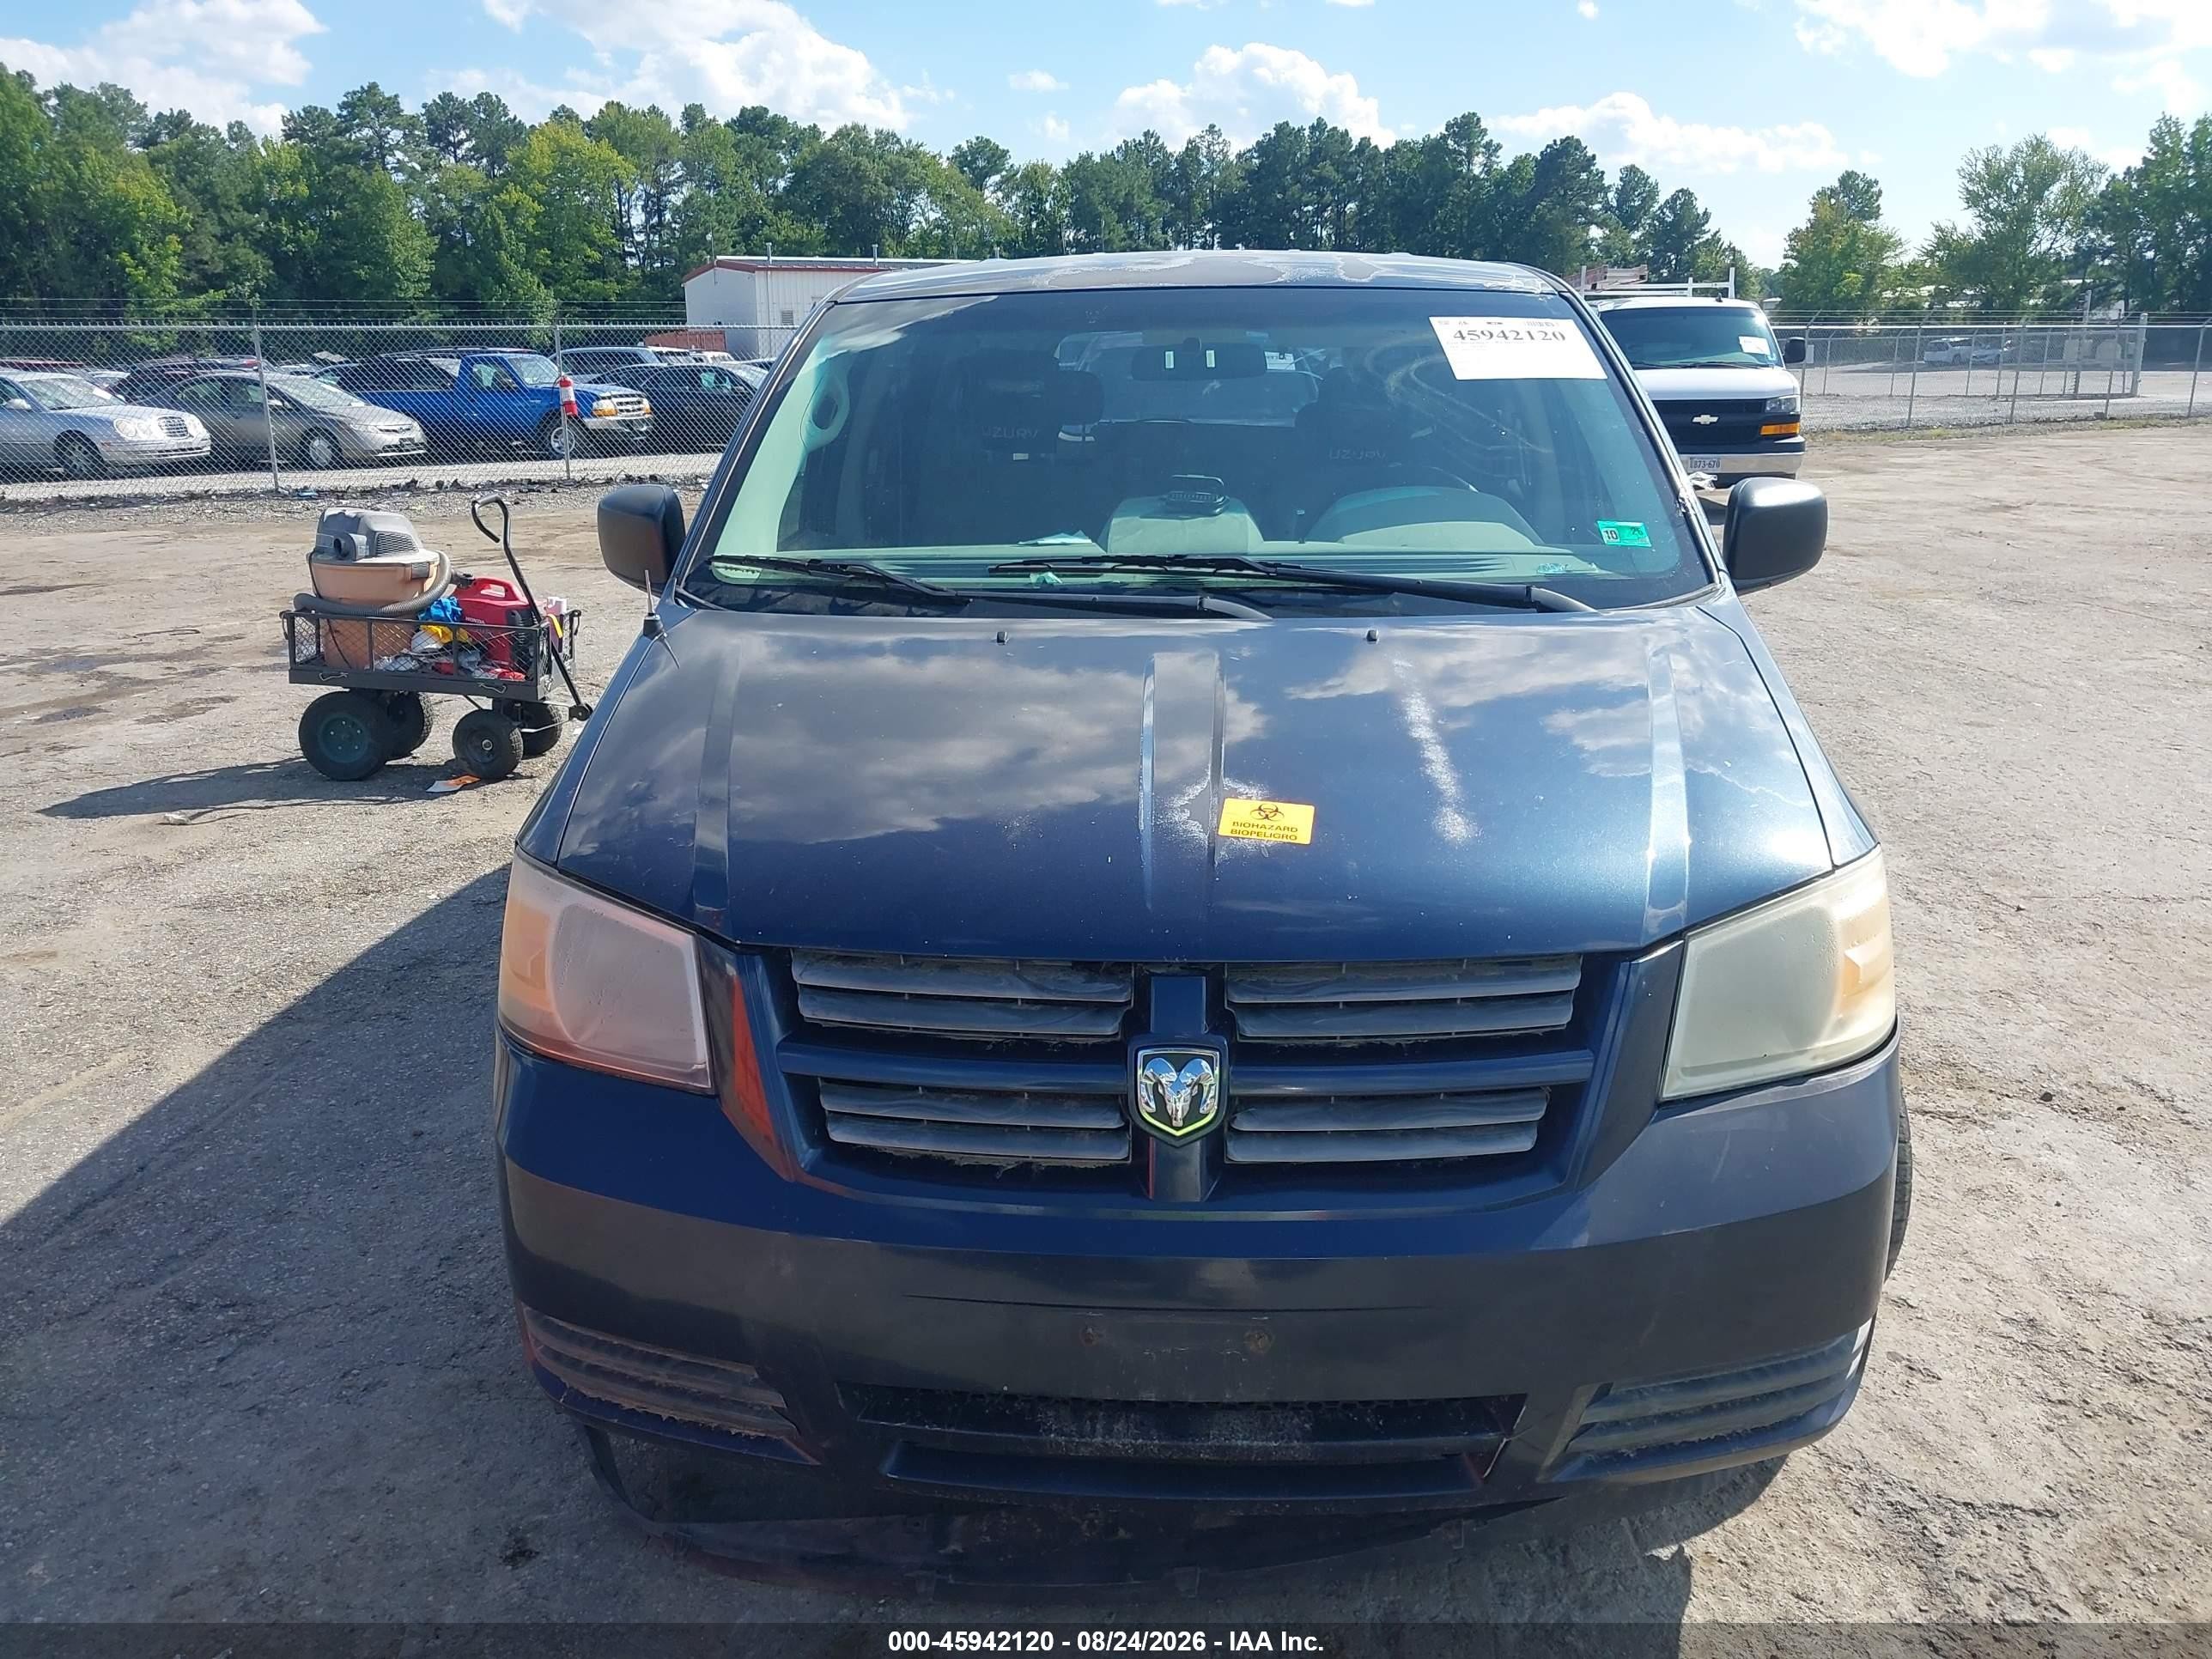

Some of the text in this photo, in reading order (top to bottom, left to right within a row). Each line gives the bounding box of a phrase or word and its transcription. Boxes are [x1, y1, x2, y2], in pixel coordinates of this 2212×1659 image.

[1453, 329, 1566, 342] 45942120
[1232, 821, 1298, 833] BIOHAZARD
[1230, 829, 1298, 841] BIOPELIGRO
